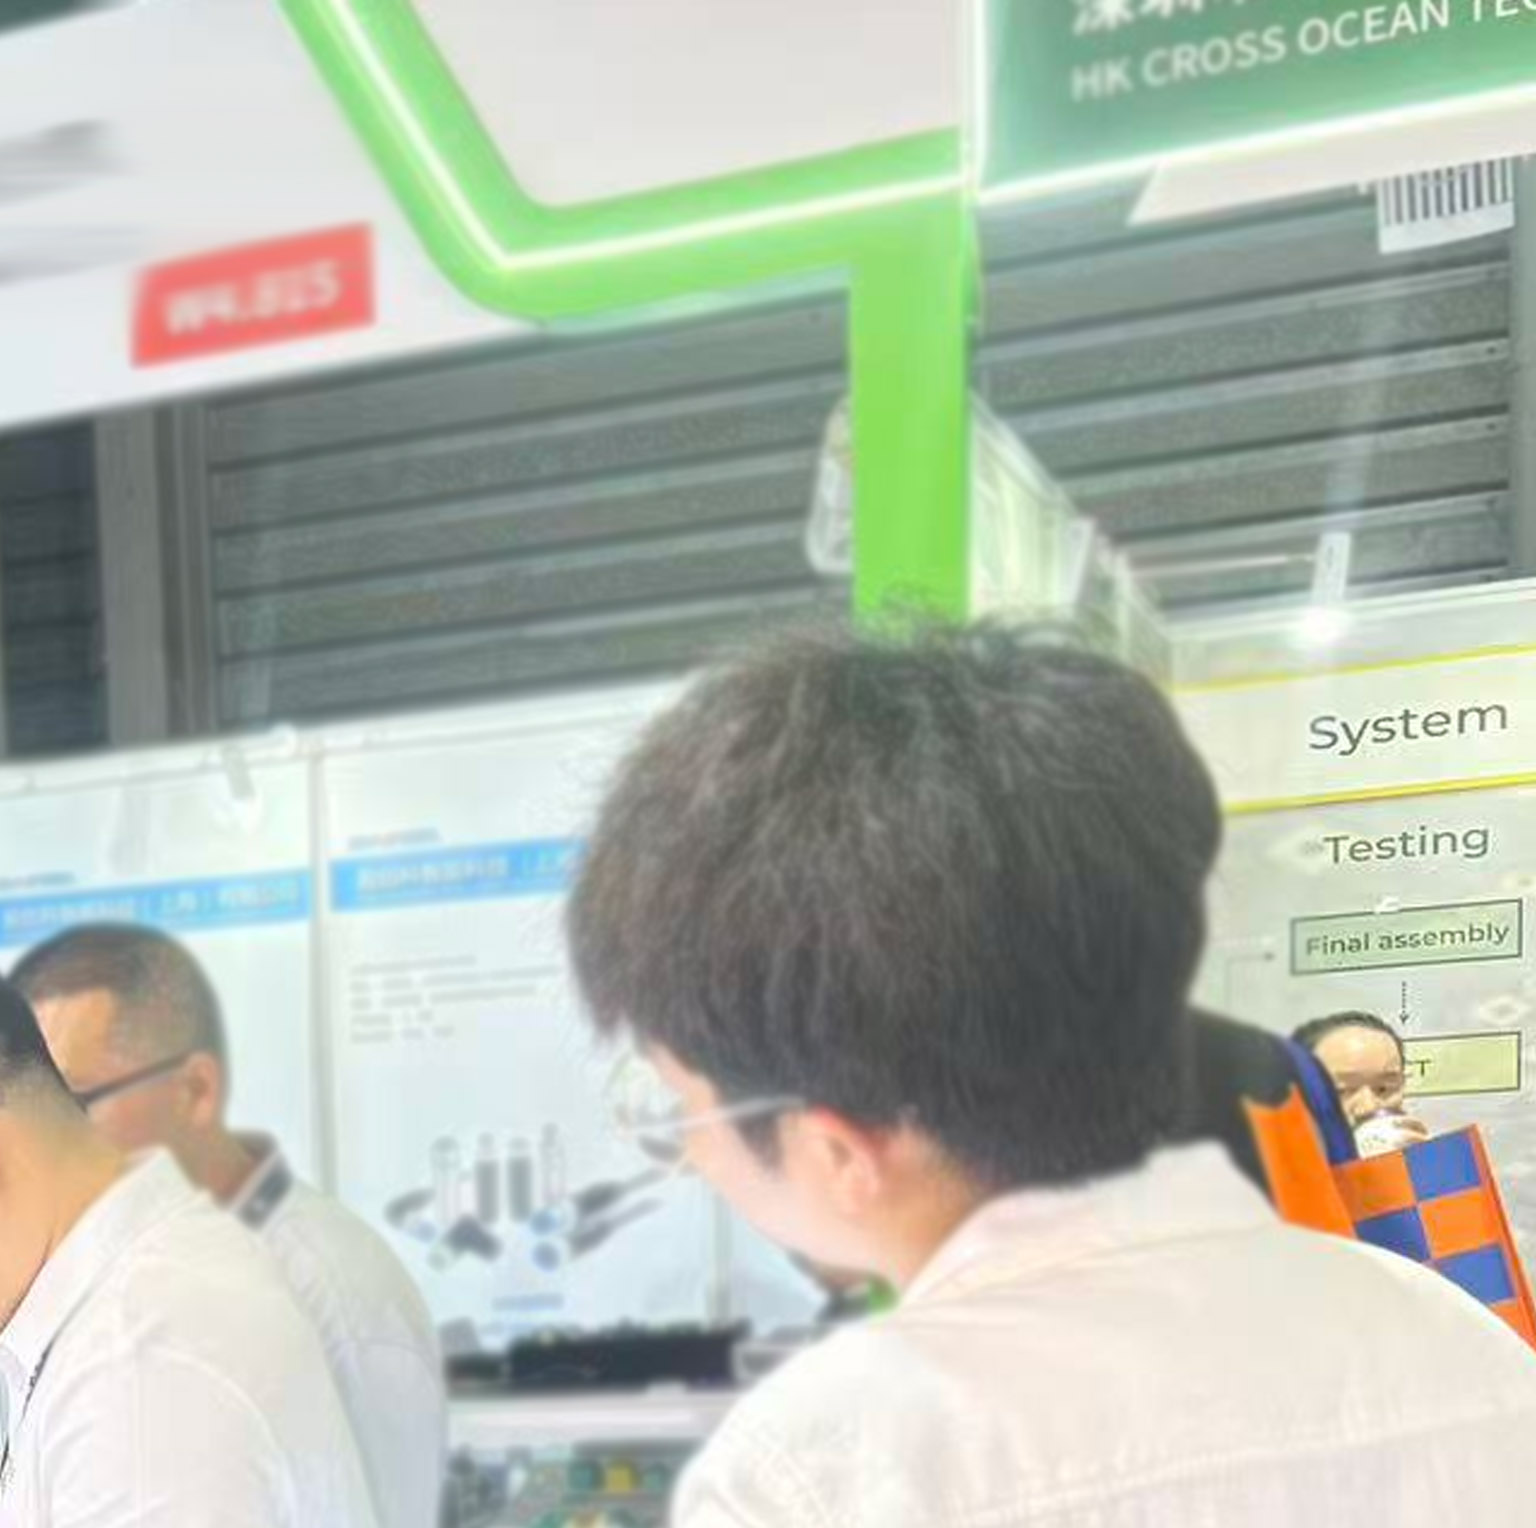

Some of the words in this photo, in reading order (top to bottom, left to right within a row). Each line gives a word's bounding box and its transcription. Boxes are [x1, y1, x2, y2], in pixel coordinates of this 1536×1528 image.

[1071, 56, 1133, 101] HK
[1142, 25, 1287, 87] CROSS
[1298, 0, 1449, 54] OCEAN
[1308, 703, 1508, 756] System
[1322, 824, 1489, 865] Testing
[1305, 932, 1370, 956] Final
[1378, 921, 1510, 950] assembly
